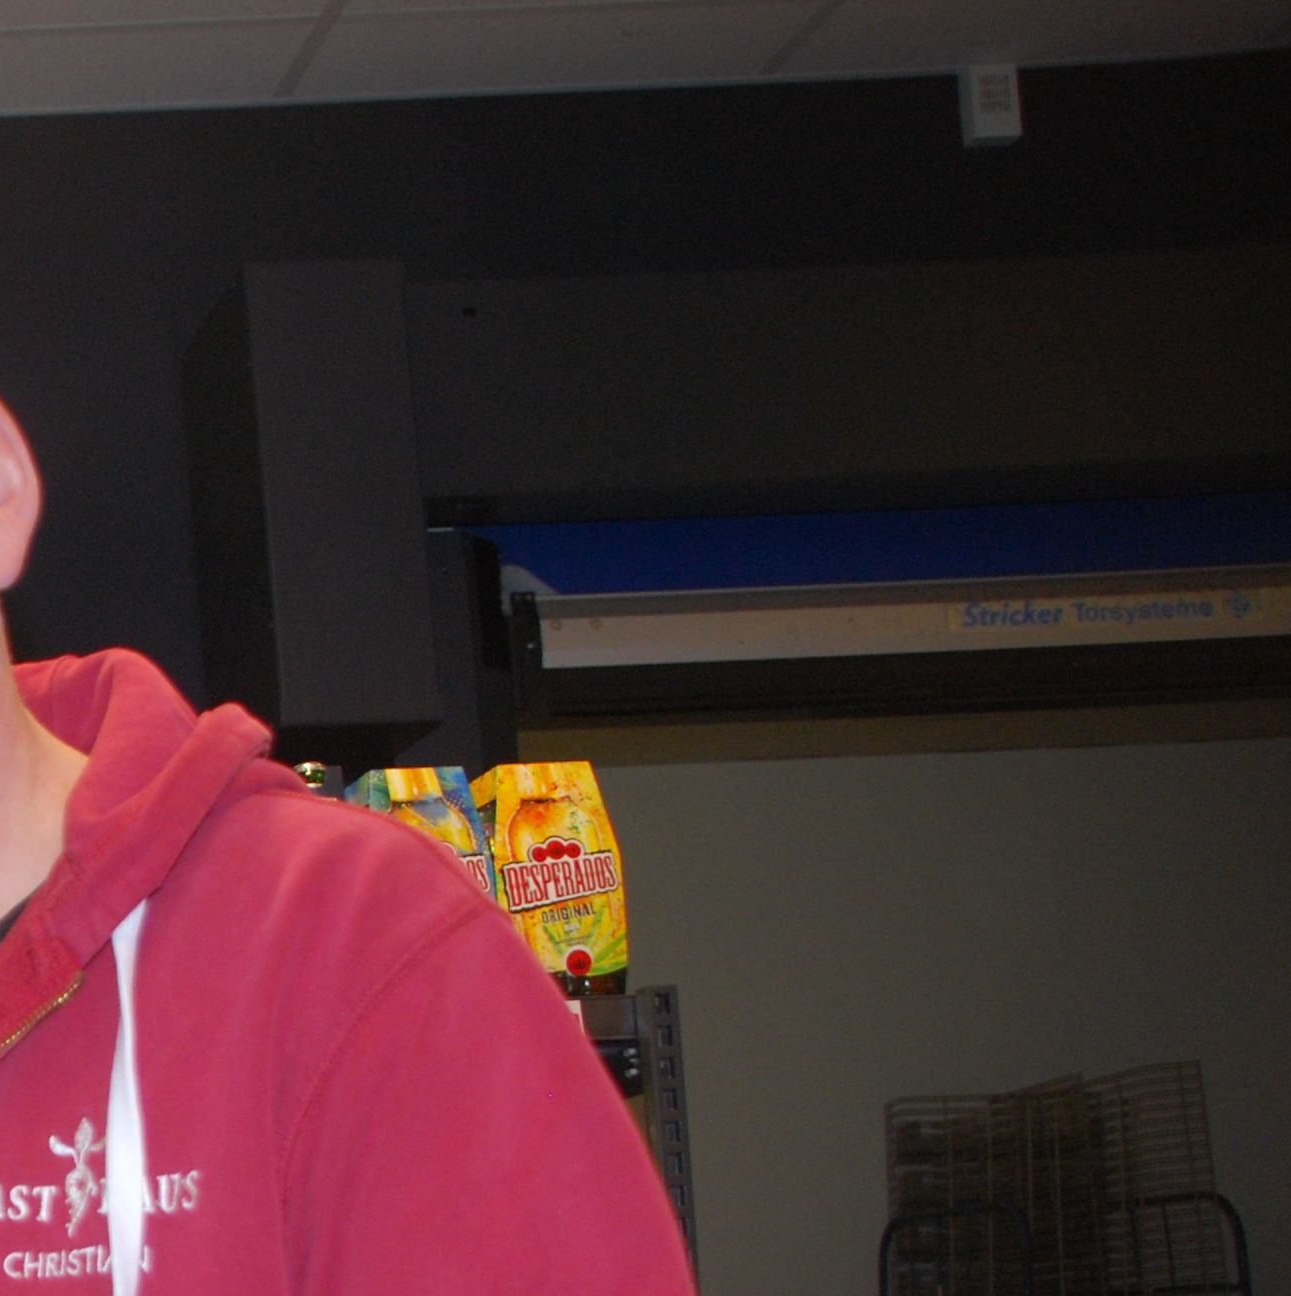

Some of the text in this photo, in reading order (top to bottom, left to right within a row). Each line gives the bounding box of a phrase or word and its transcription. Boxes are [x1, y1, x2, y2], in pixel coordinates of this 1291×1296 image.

[962, 598, 1214, 629] Stricker Torsysteme
[506, 855, 617, 907] DESPERADOS
[540, 901, 596, 923] ORIGINAL
